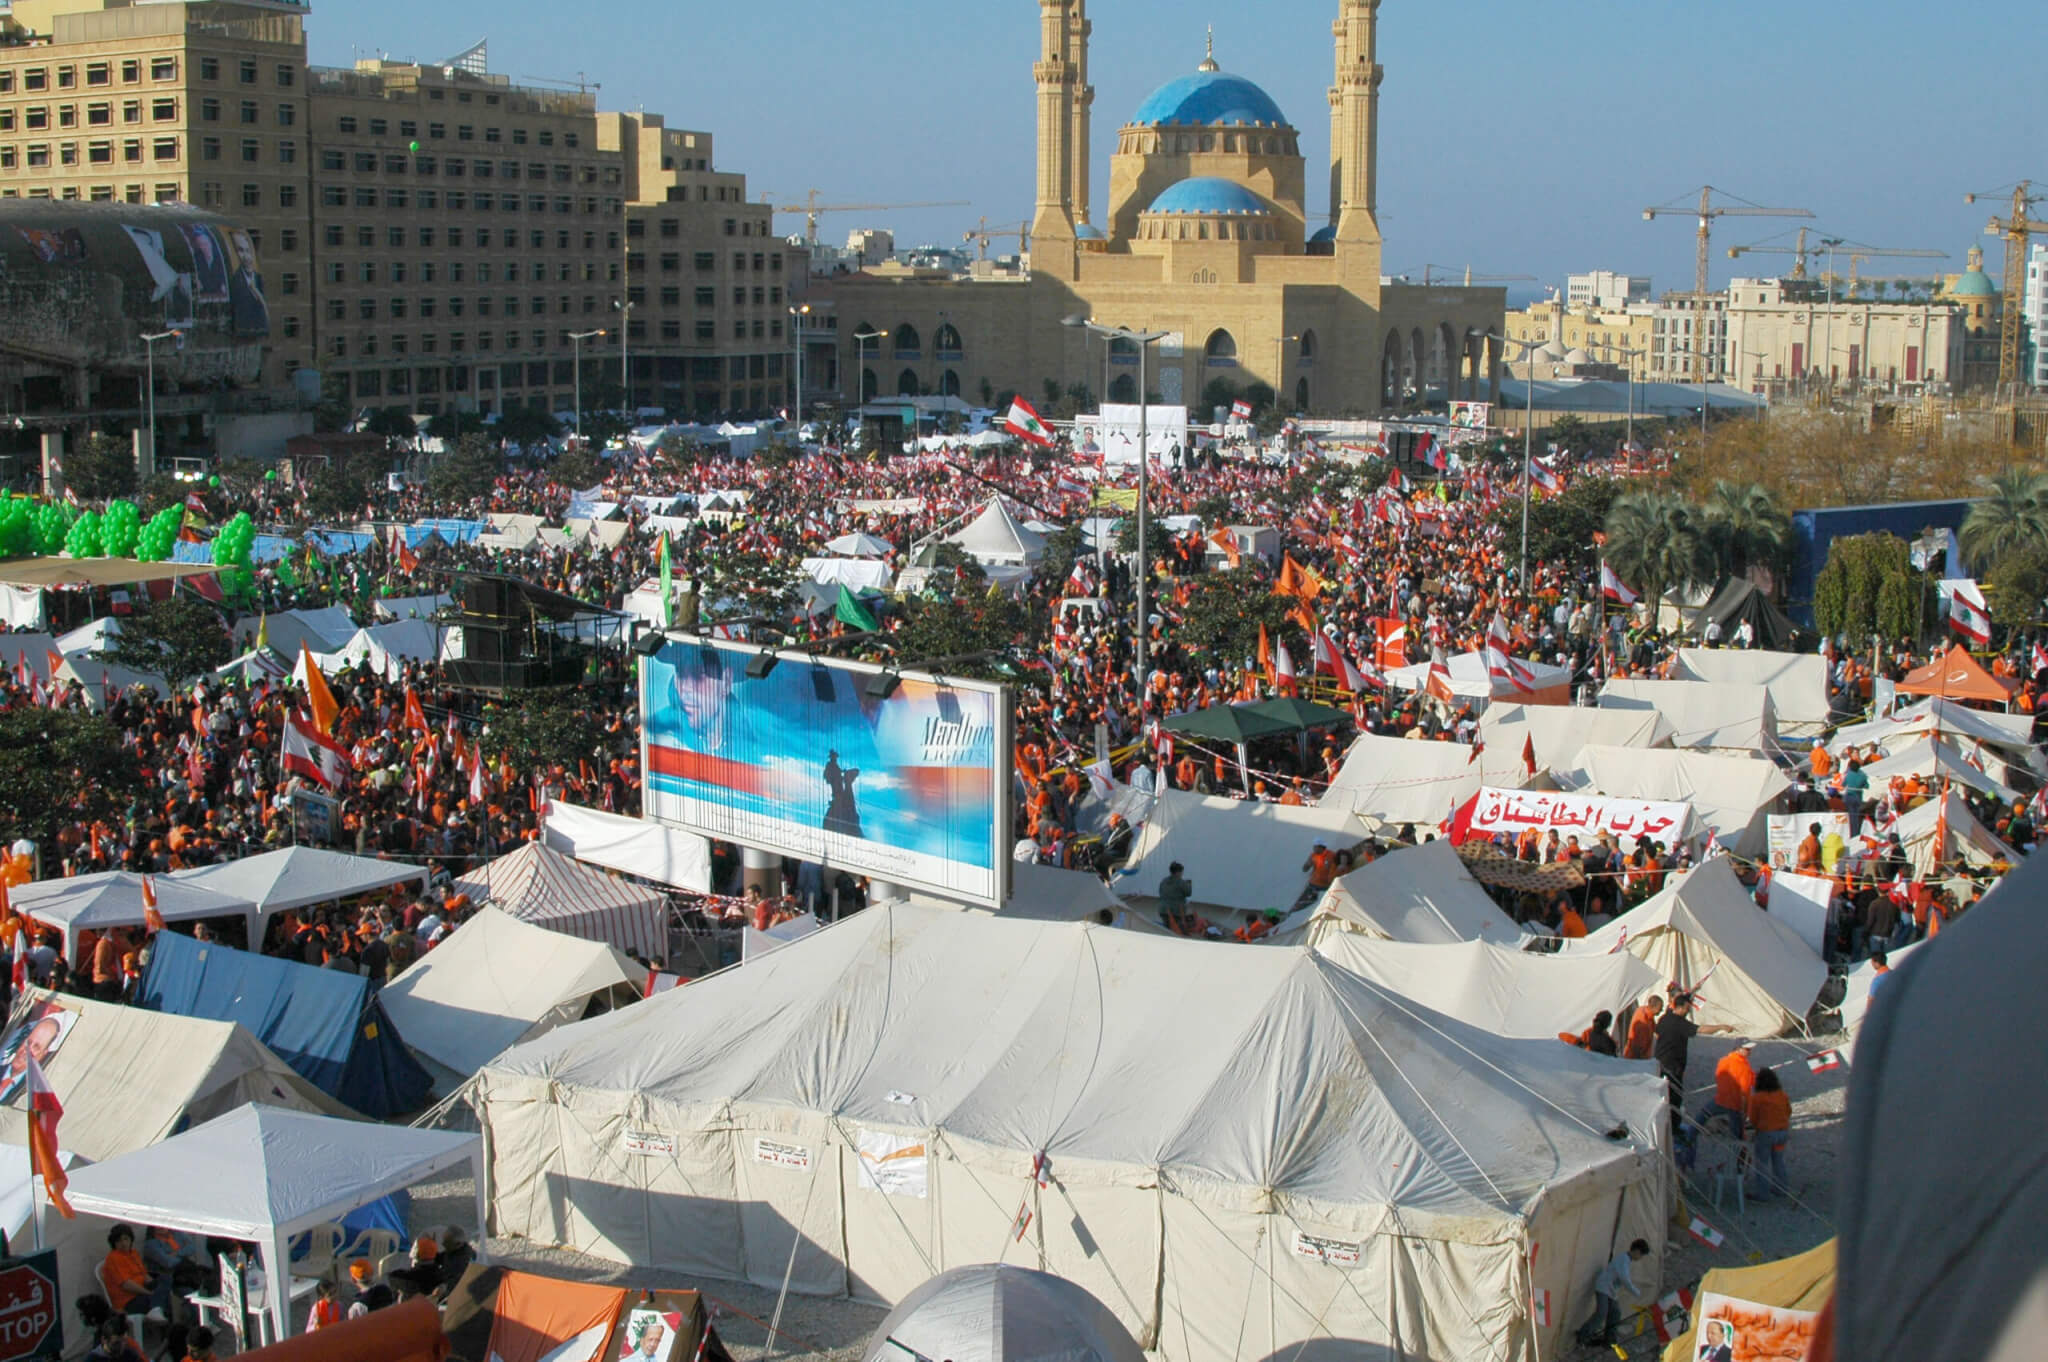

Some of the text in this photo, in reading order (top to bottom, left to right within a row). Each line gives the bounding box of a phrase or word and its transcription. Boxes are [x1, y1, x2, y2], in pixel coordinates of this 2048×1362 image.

[1479, 791, 1676, 841] حزب الطاشناق
[0, 1311, 48, 1344] TOP
